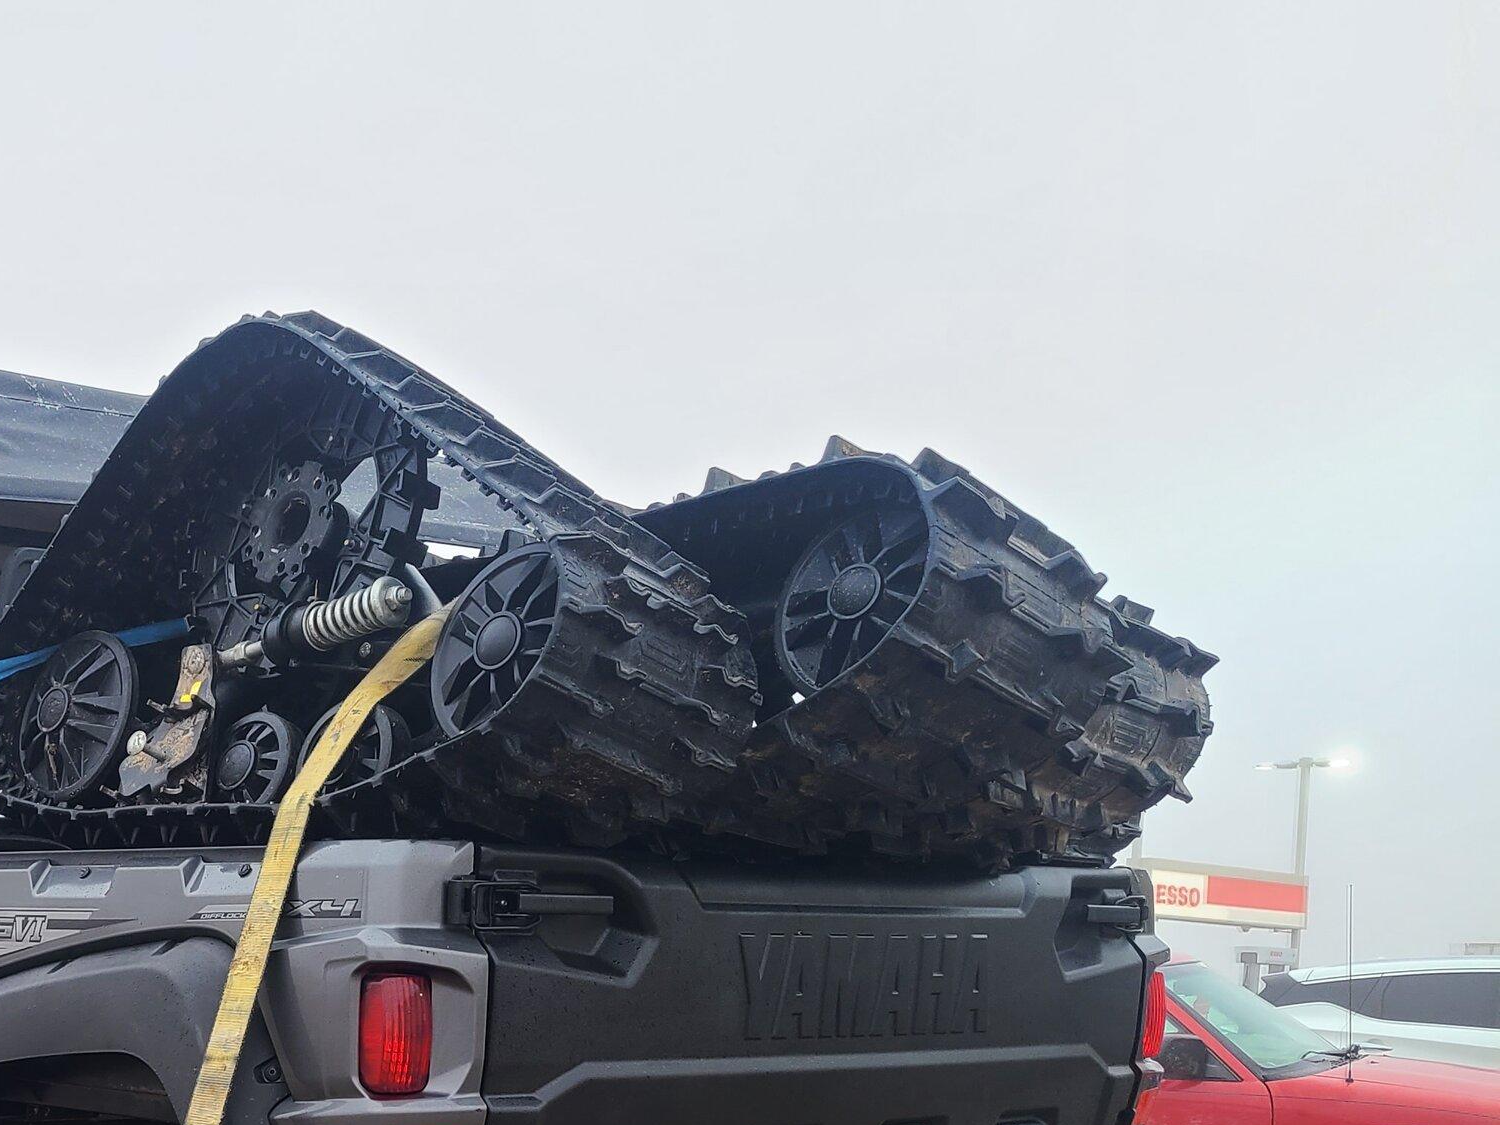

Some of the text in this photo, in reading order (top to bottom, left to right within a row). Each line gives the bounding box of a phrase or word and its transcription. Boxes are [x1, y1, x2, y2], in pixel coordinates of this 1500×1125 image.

[1156, 884, 1200, 907] ESSO
[13, 914, 47, 943] VI
[200, 912, 247, 920] DIFFLOCK
[739, 932, 988, 1041] YAMAHA
